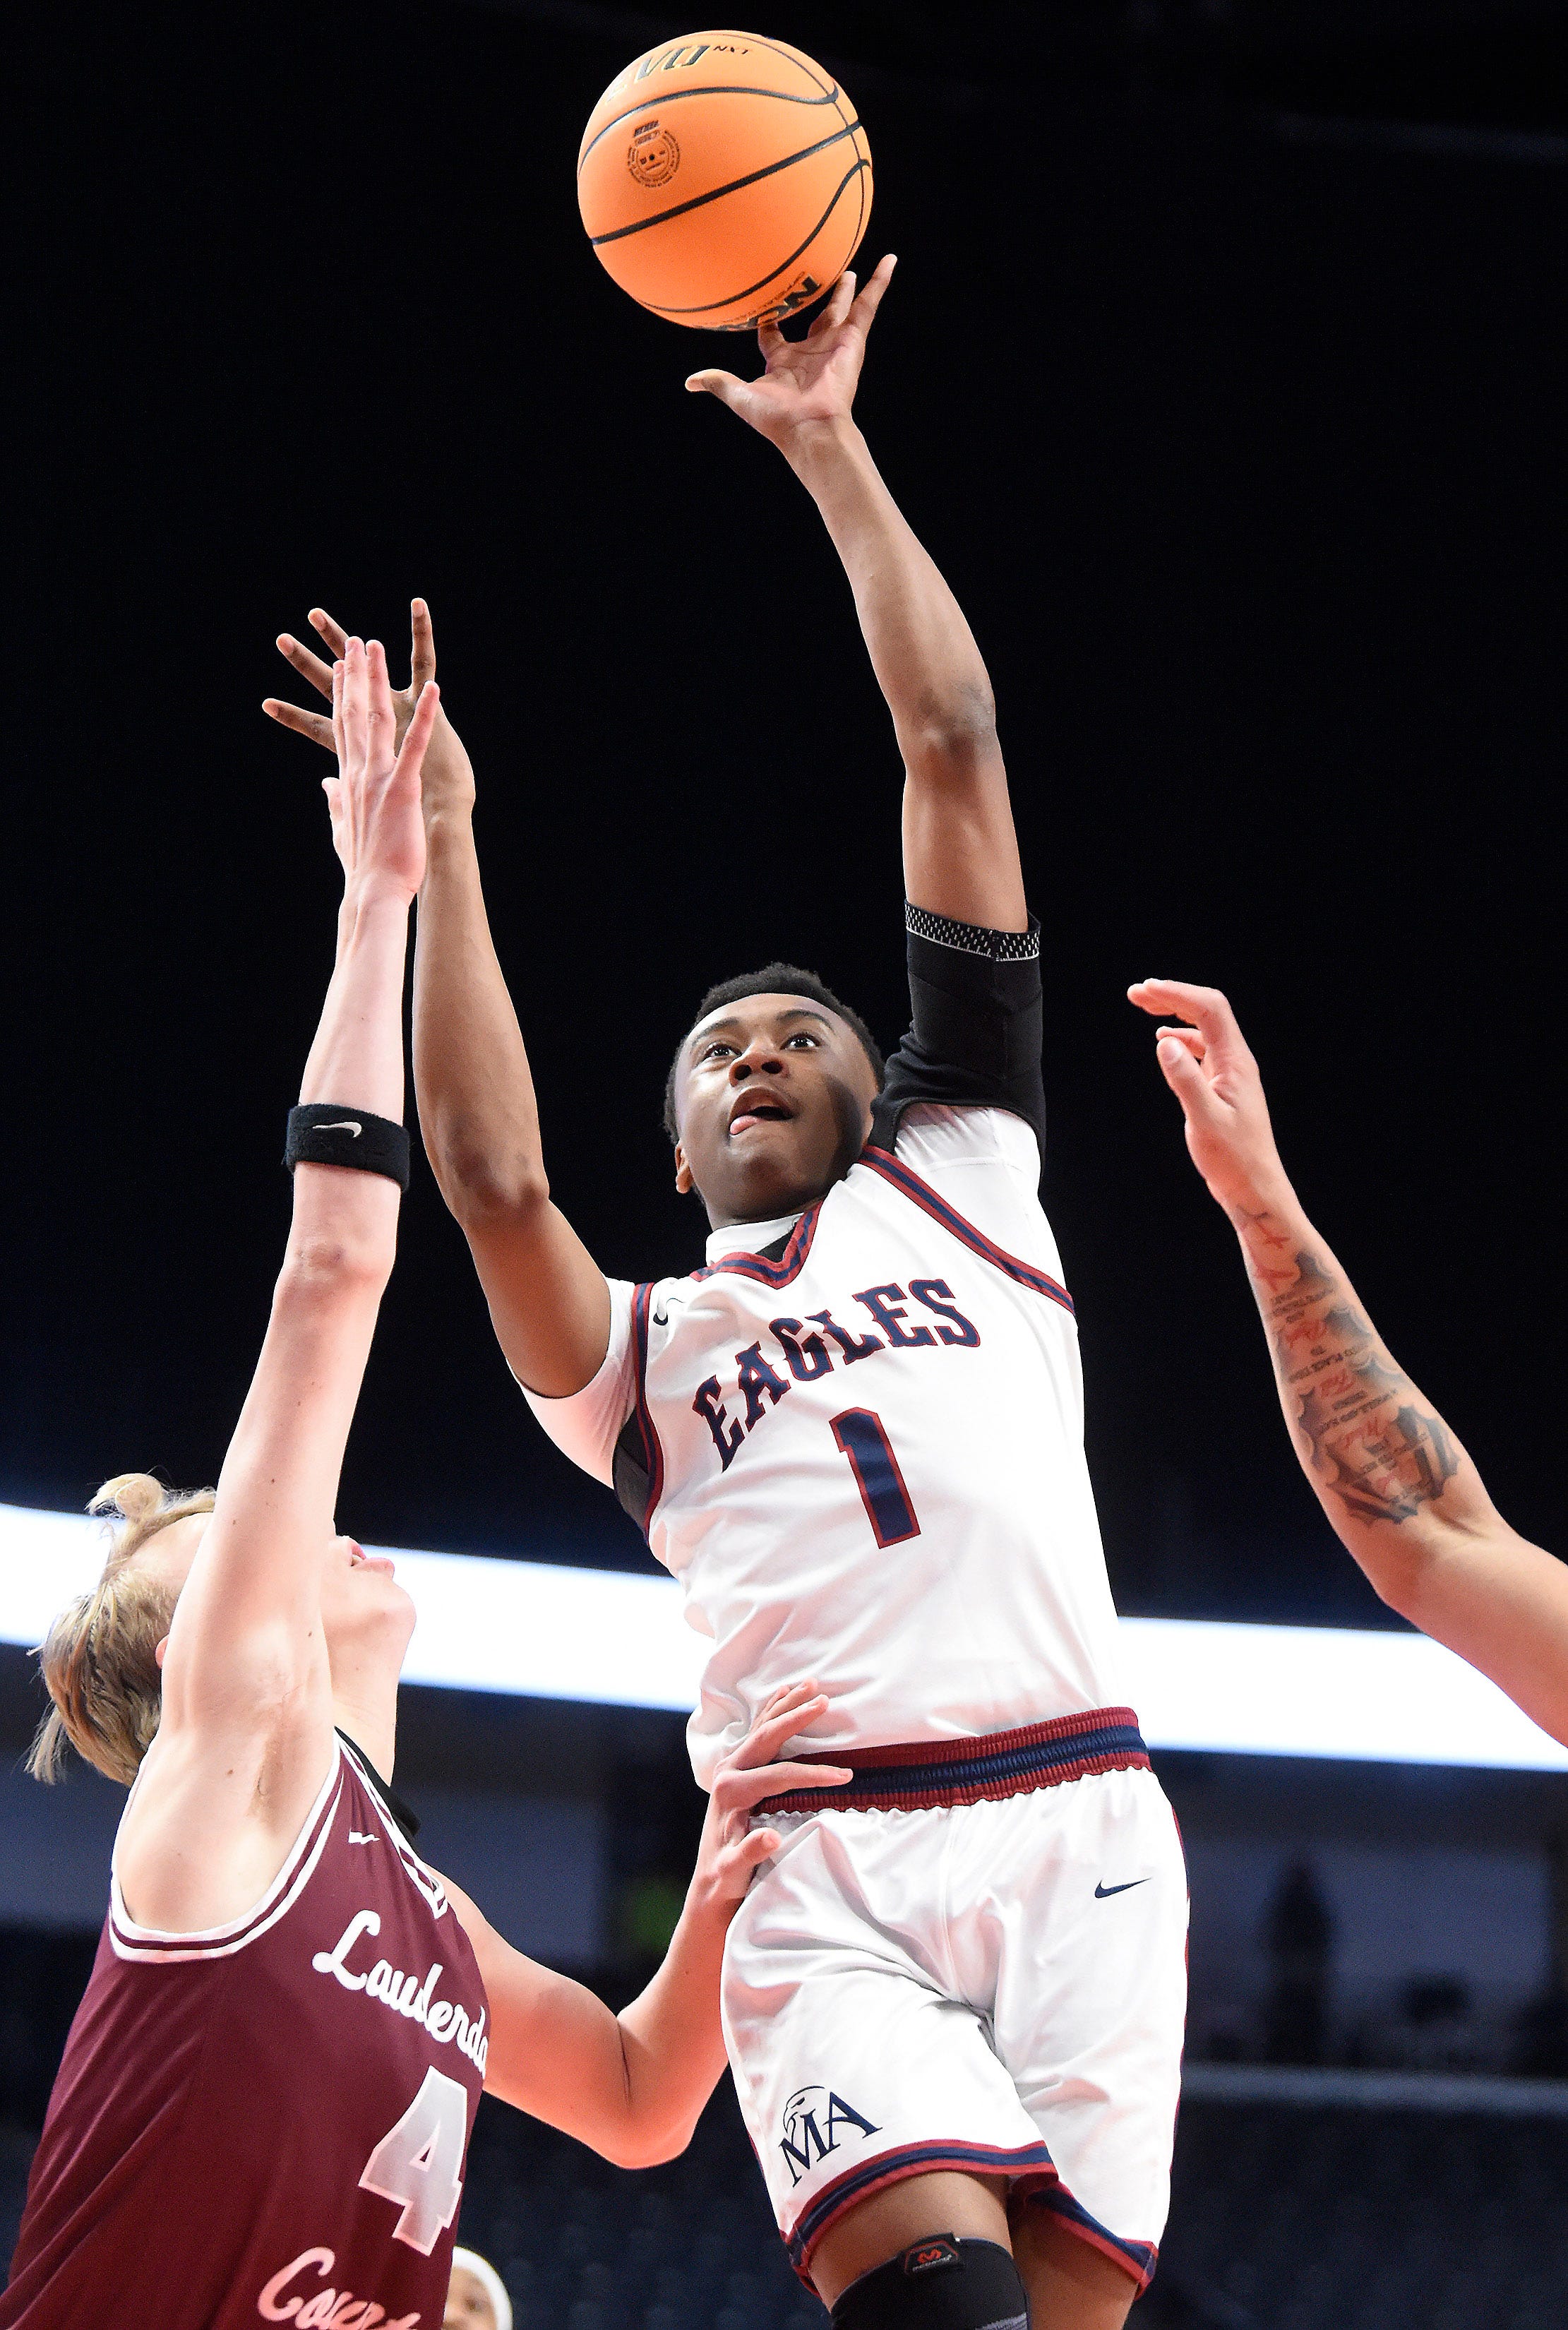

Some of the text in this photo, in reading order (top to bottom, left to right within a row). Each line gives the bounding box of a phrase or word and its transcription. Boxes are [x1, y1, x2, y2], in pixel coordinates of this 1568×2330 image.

[693, 1279, 981, 1472] EAGLES
[829, 1407, 921, 1549] 1
[359, 2065, 467, 2256] 4
[779, 2091, 882, 2187] MA
